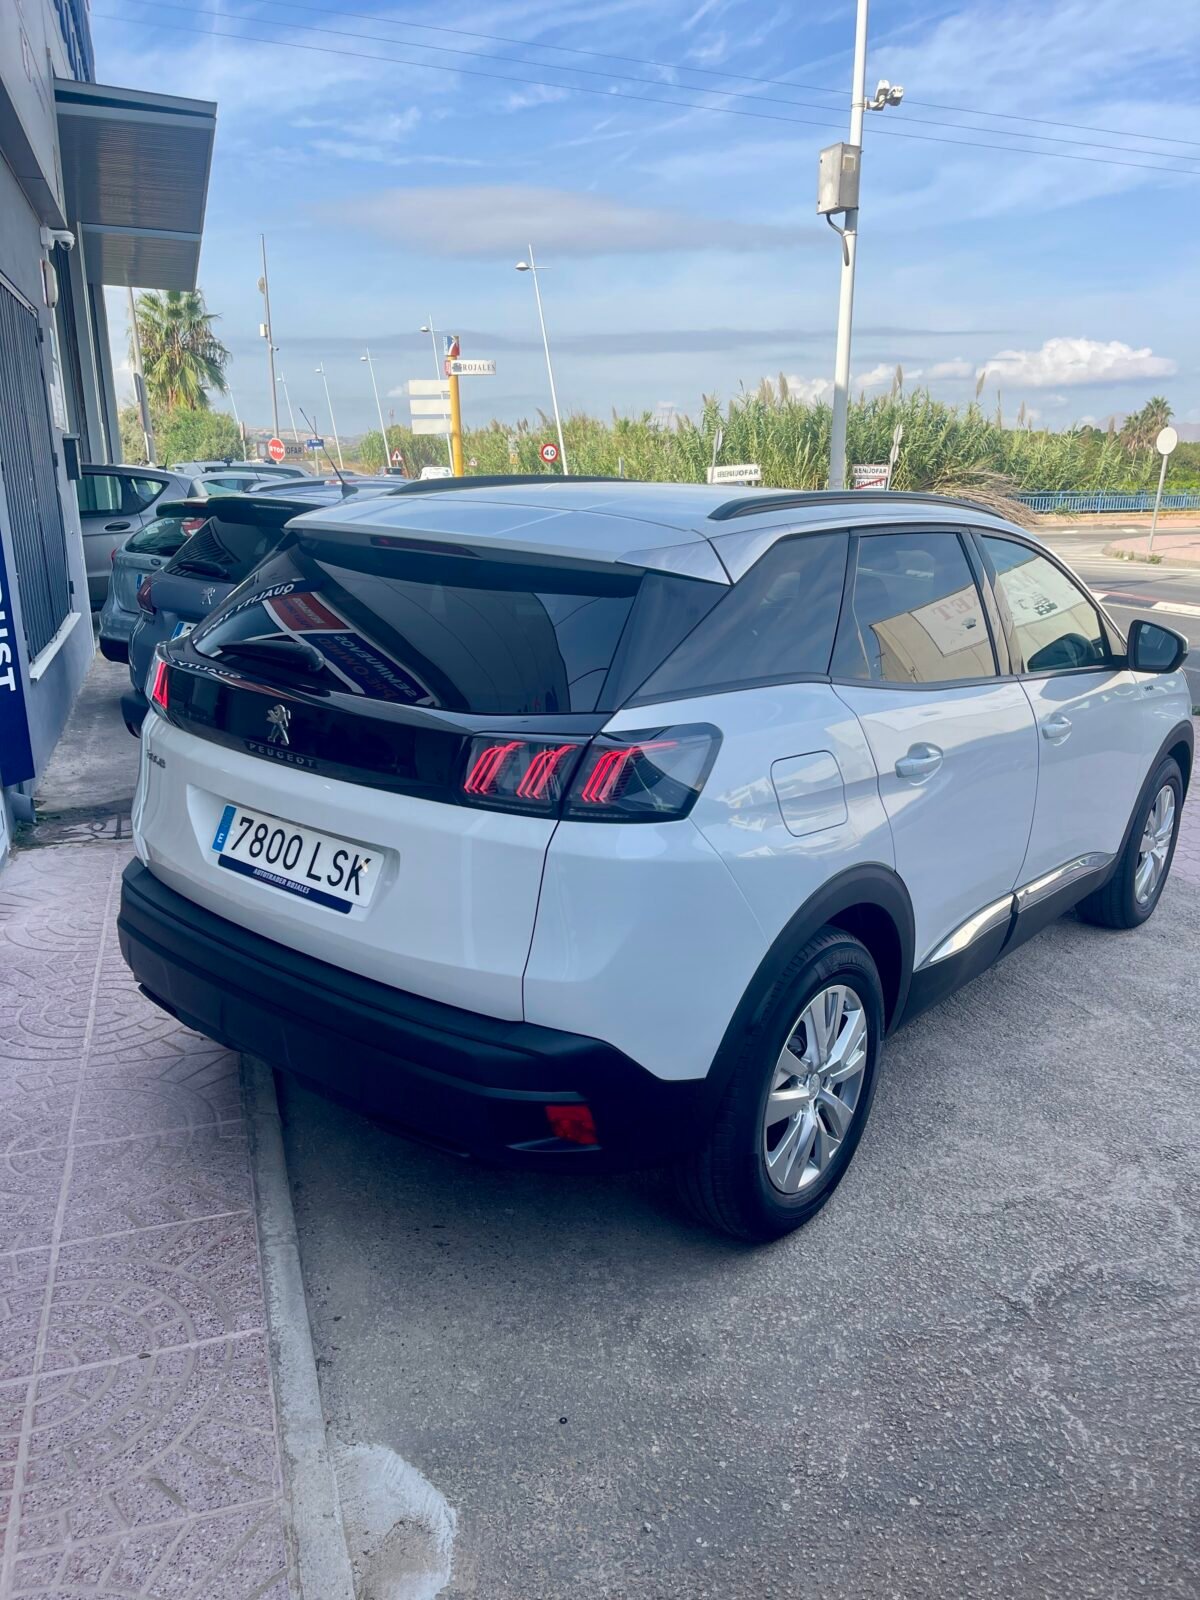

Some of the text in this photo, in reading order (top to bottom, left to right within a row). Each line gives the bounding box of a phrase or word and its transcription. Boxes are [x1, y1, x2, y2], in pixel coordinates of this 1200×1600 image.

[270, 445, 284, 454] STOP
[249, 742, 315, 767] PEUGEOT
[231, 816, 371, 896] 7800 LSK
[252, 867, 311, 894] AUTOTRADER ROJALES
